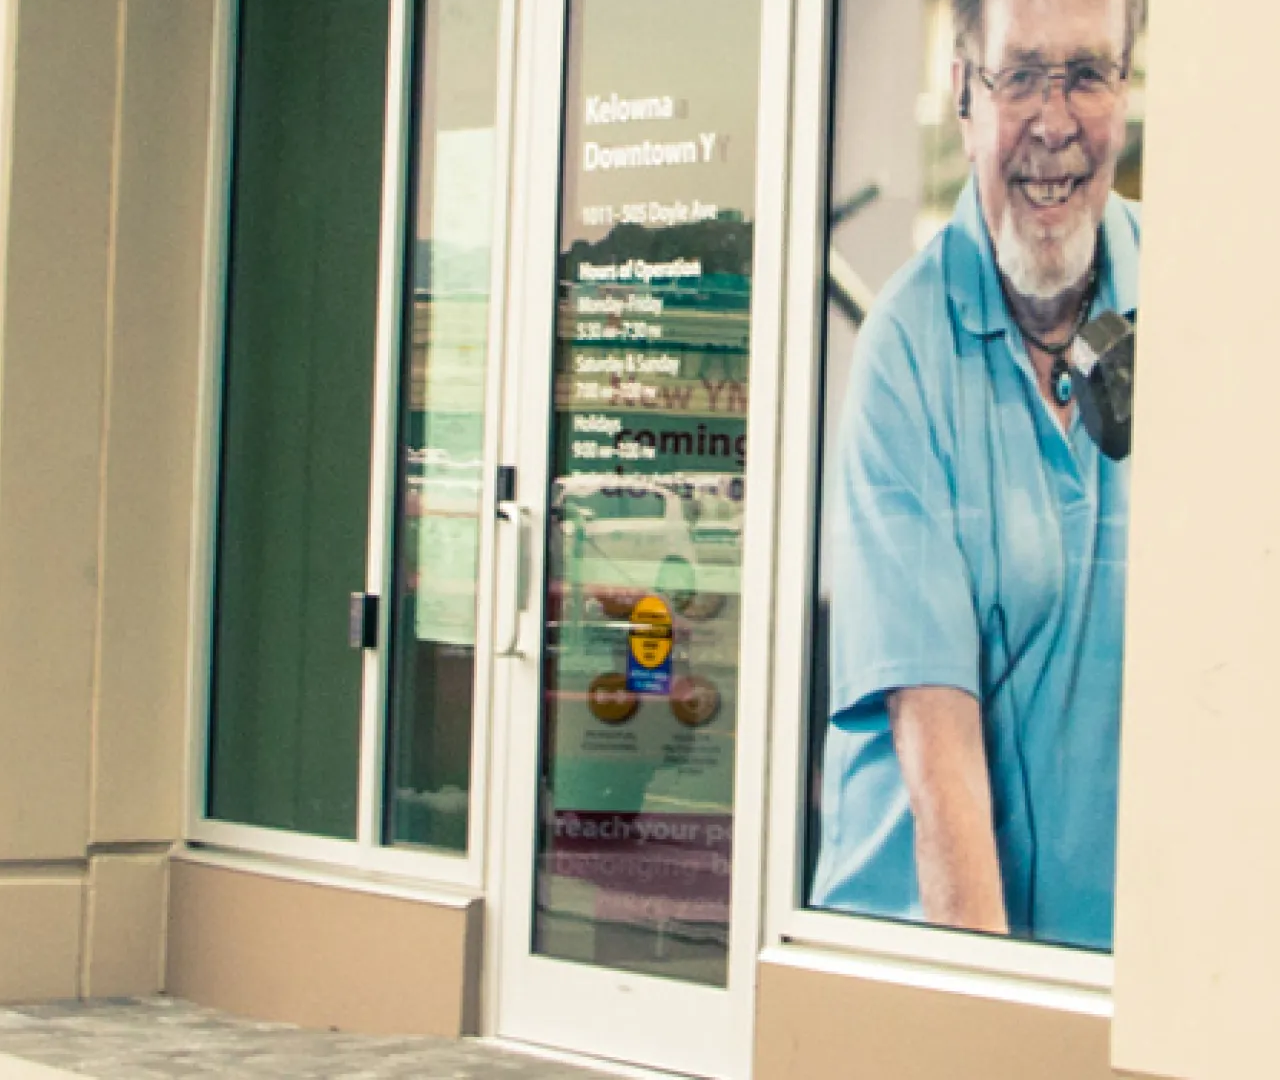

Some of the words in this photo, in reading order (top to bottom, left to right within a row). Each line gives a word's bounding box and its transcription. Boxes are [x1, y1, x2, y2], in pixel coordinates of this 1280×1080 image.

[585, 93, 673, 124] Kelowna
[583, 140, 696, 171] Downtown
[699, 132, 716, 162] Y
[648, 200, 687, 226] Doyle
[578, 262, 616, 280] Hours
[619, 259, 633, 280] of
[634, 257, 701, 284] Operation
[636, 820, 701, 845] your
